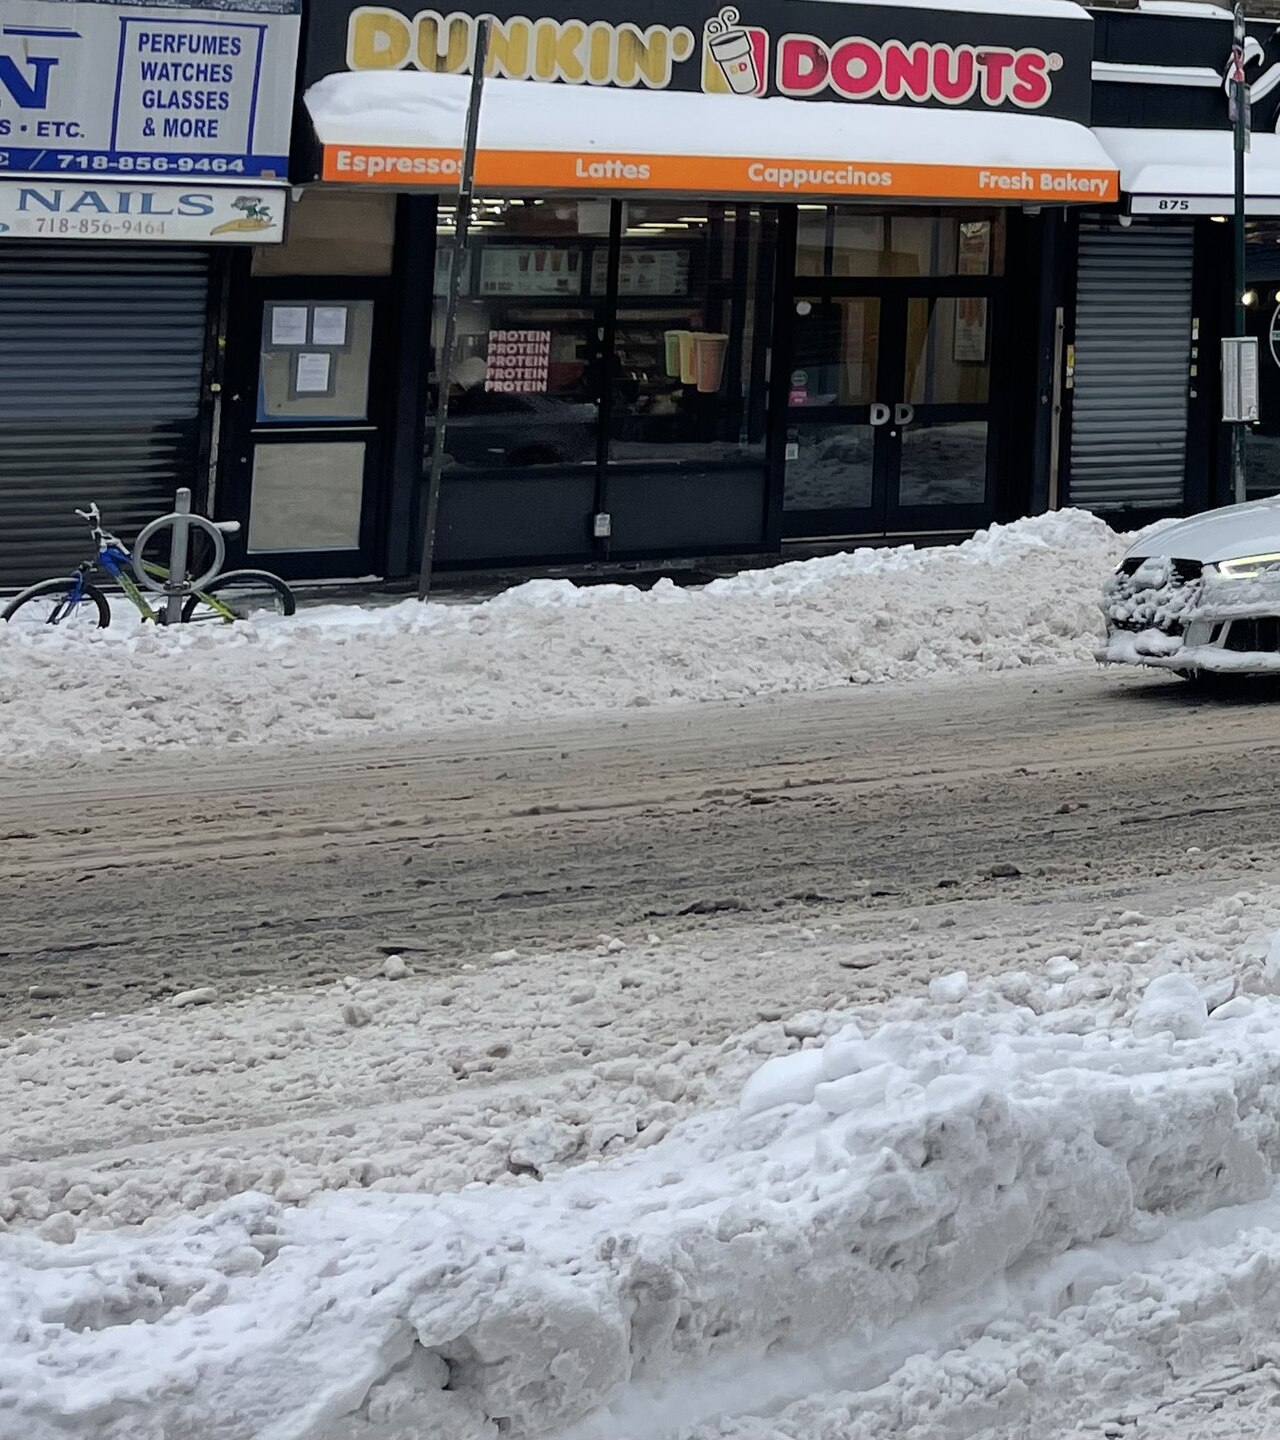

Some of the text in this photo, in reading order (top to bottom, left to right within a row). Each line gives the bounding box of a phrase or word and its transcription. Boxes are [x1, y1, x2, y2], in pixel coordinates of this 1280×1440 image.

[138, 32, 242, 56] PERFUMES
[349, 9, 1051, 107] DUNKIN' DONUTS
[140, 61, 233, 83] WATCHES
[142, 89, 230, 111] GLASSES
[36, 121, 85, 138] ETC.
[142, 117, 219, 138] & MORE
[57, 154, 245, 173] 718-856-9464
[575, 158, 651, 181] Lattes
[747, 162, 893, 188] Cappuccinos
[978, 170, 1034, 191] Fresh
[1040, 173, 1109, 197] Bakery
[16, 188, 215, 216] NAILS
[1159, 199, 1189, 210] 875
[36, 218, 165, 235] 718-856-9464
[489, 330, 551, 342] PROTEIN
[488, 343, 550, 355] PROTEIN
[487, 356, 549, 367] PROTEIN
[486, 368, 548, 379] PROTEIN
[485, 381, 547, 392] PROTEIN
